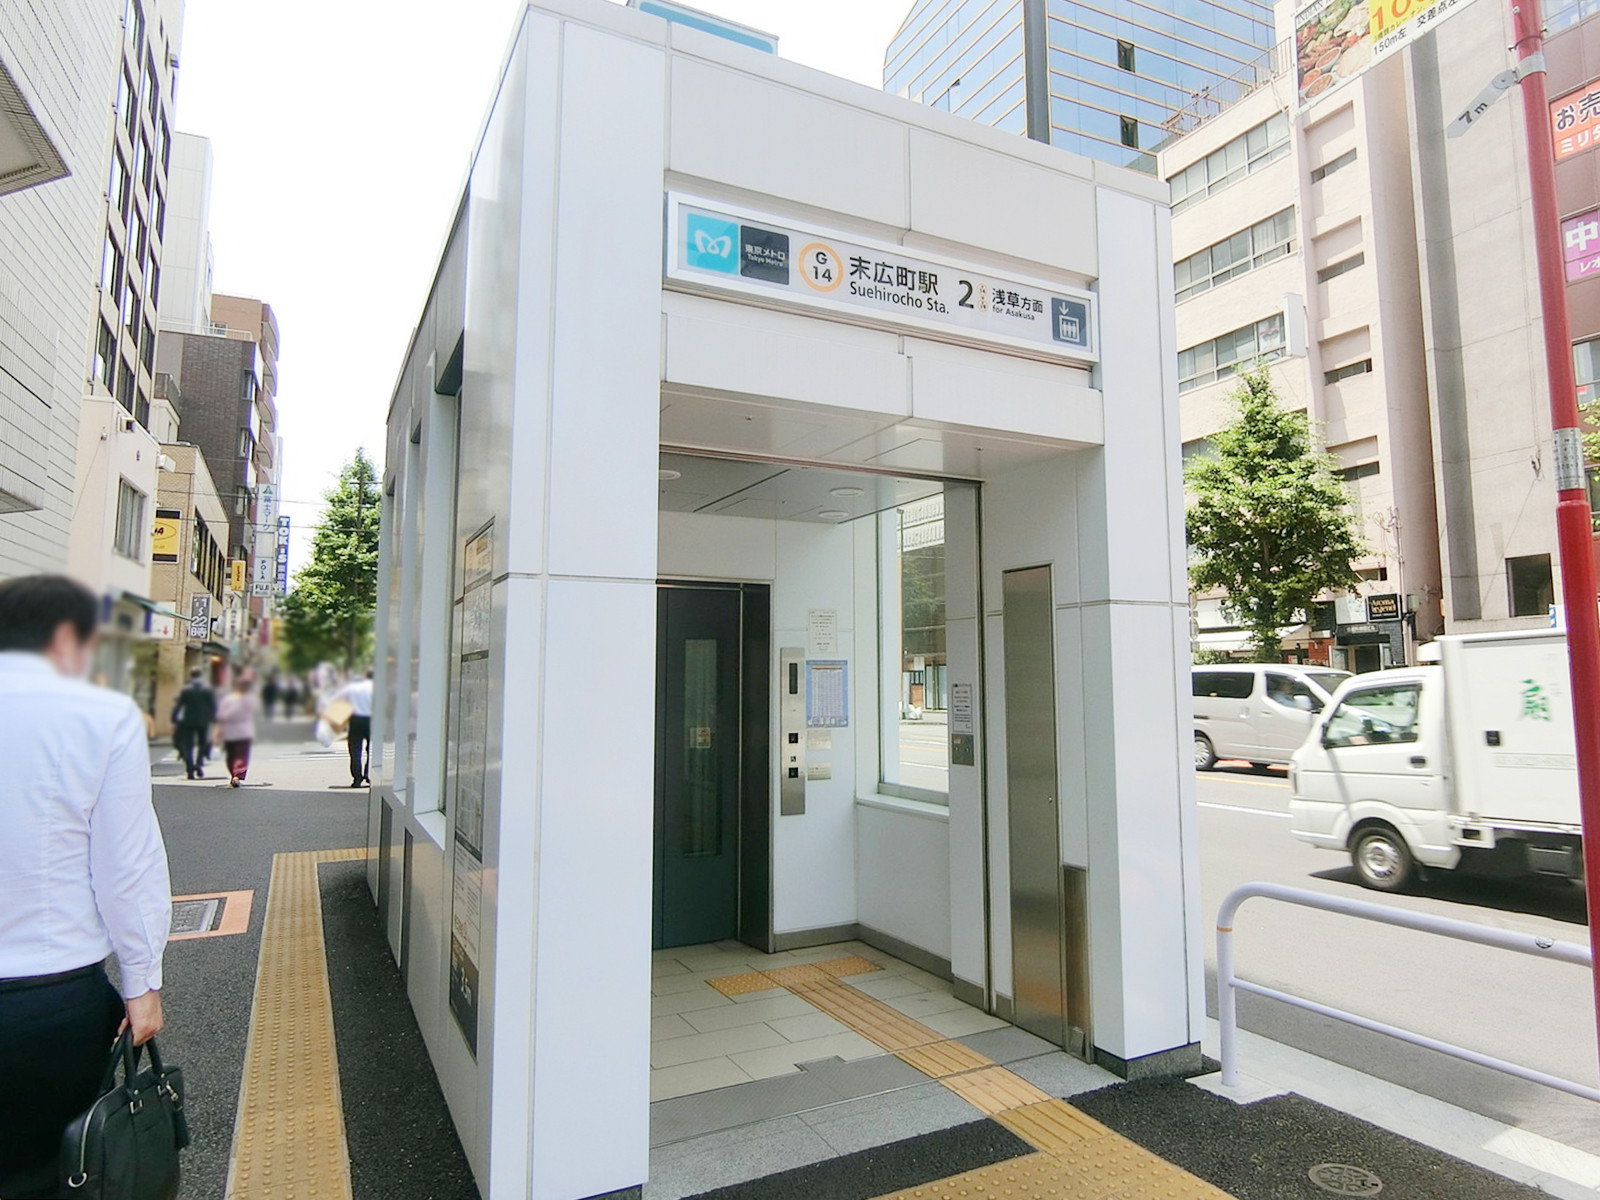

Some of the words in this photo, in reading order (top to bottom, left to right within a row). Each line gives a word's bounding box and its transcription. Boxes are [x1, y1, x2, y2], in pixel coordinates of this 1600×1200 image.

[1373, 27, 1407, 55] 150m左
[745, 244, 785, 260] 東京メトロ
[747, 253, 765, 264] Tokyo
[765, 256, 784, 267] Metro
[815, 251, 828, 265] G
[813, 265, 833, 282] 14
[849, 256, 939, 296] 末広町駅
[850, 281, 923, 309] Suehirocho
[926, 297, 950, 314] Sta.
[958, 279, 975, 310] 2
[992, 287, 1044, 314] 浅草方面
[992, 304, 1004, 314] for
[1005, 308, 1035, 321] Asakusa
[254, 582, 270, 591] FUJI
